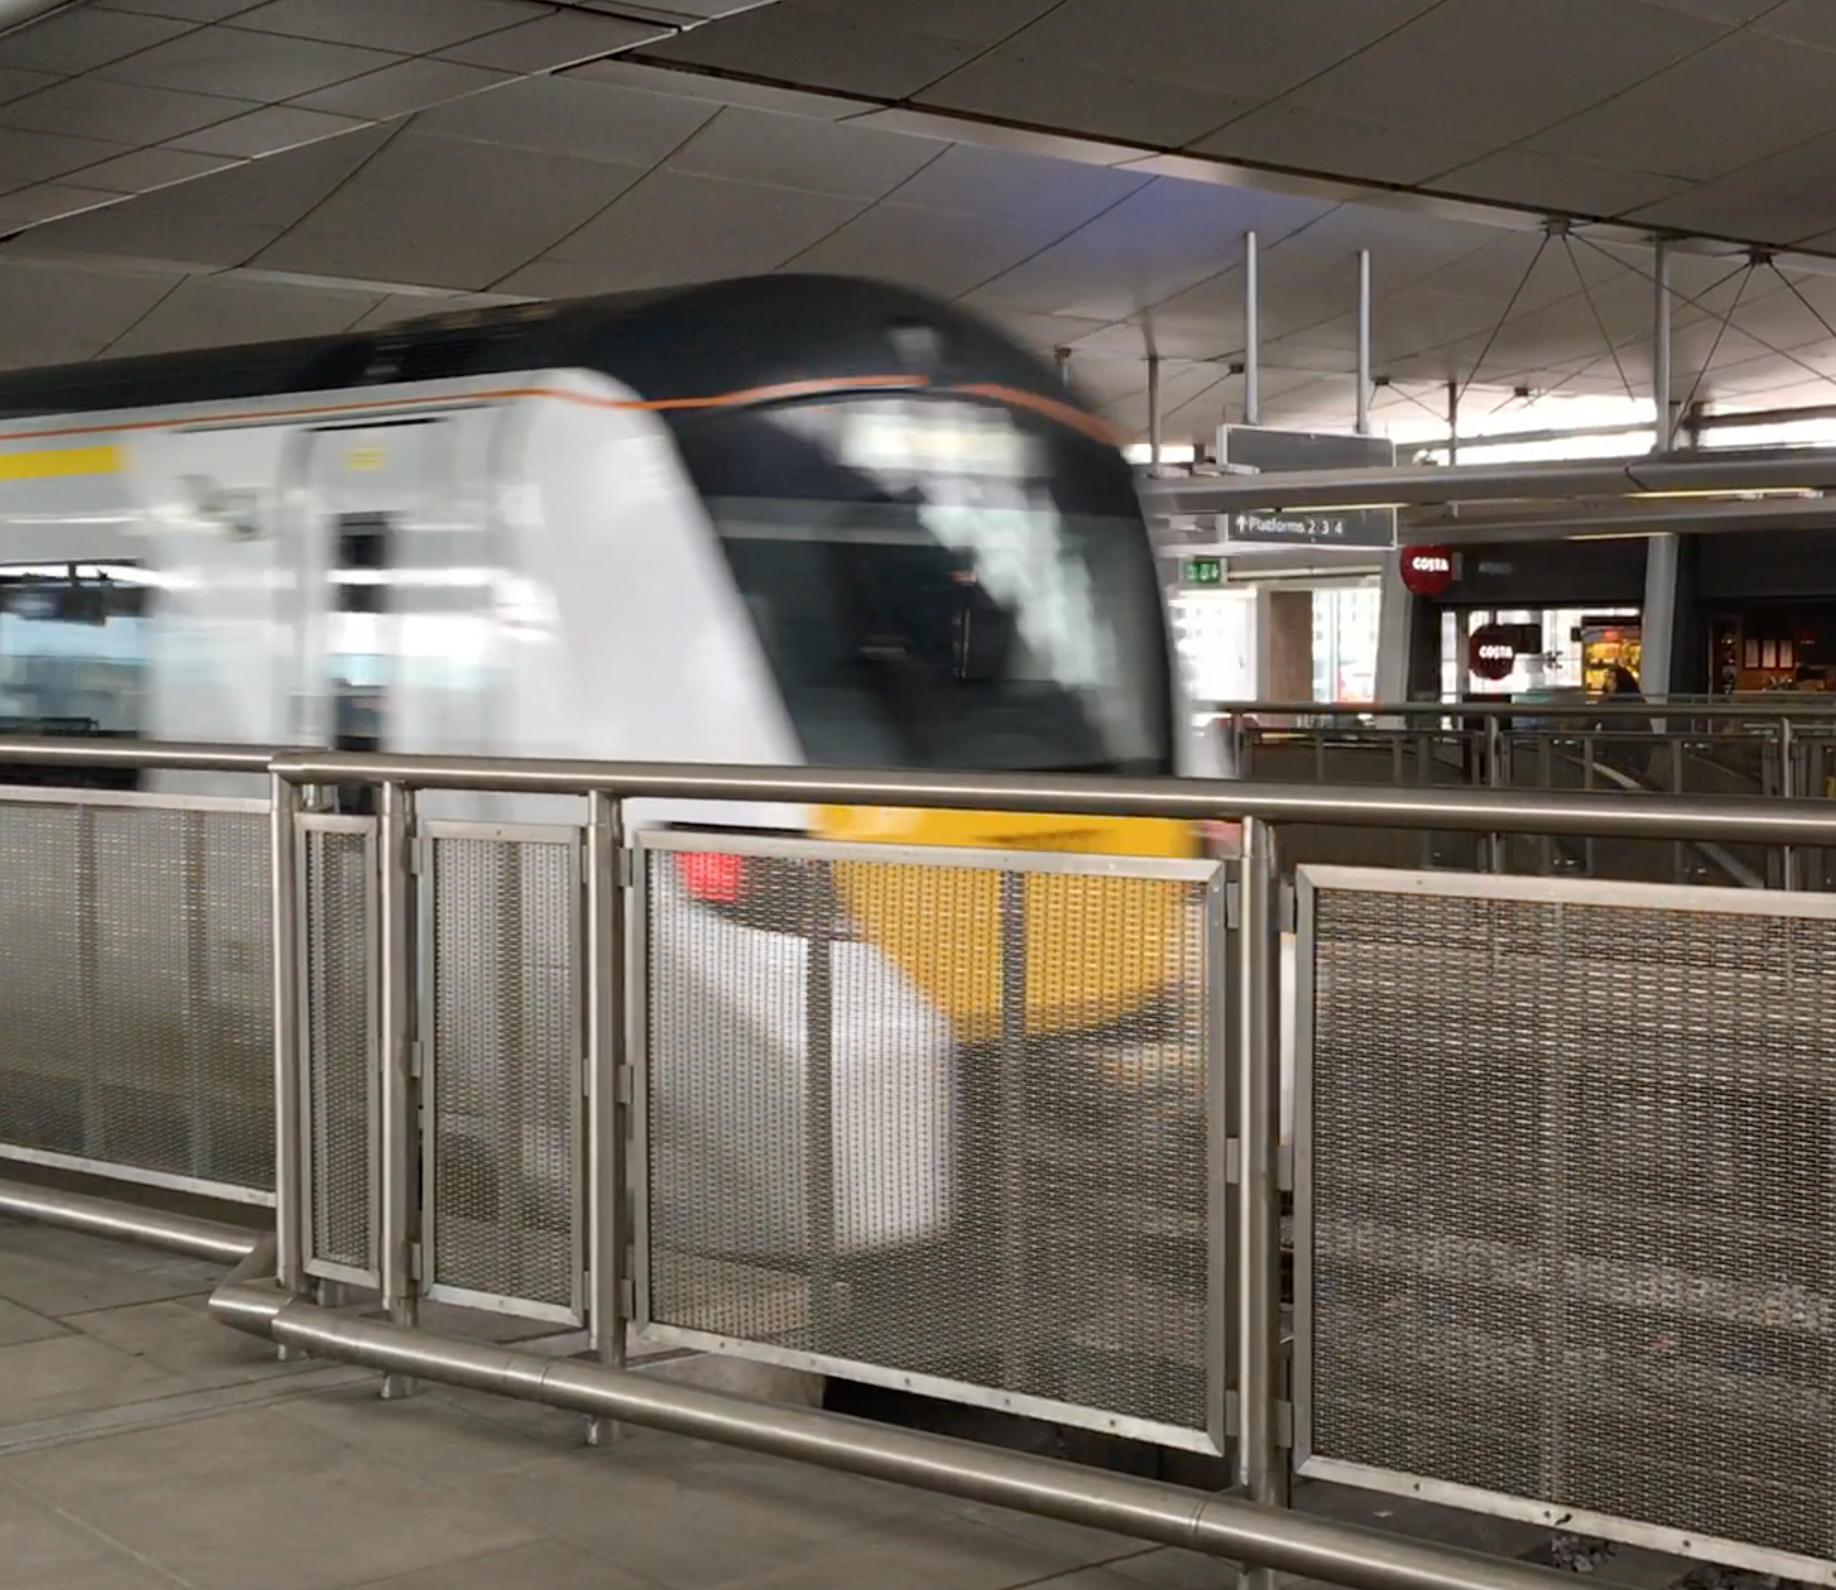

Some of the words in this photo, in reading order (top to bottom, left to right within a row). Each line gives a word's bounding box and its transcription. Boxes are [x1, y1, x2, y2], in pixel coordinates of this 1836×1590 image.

[1249, 515, 1305, 534] Platforms
[1308, 520, 1316, 534] 2
[1321, 521, 1329, 535] 3
[1334, 521, 1343, 534] 4
[1412, 557, 1449, 572] COSTA
[1479, 645, 1514, 660] COSTA
